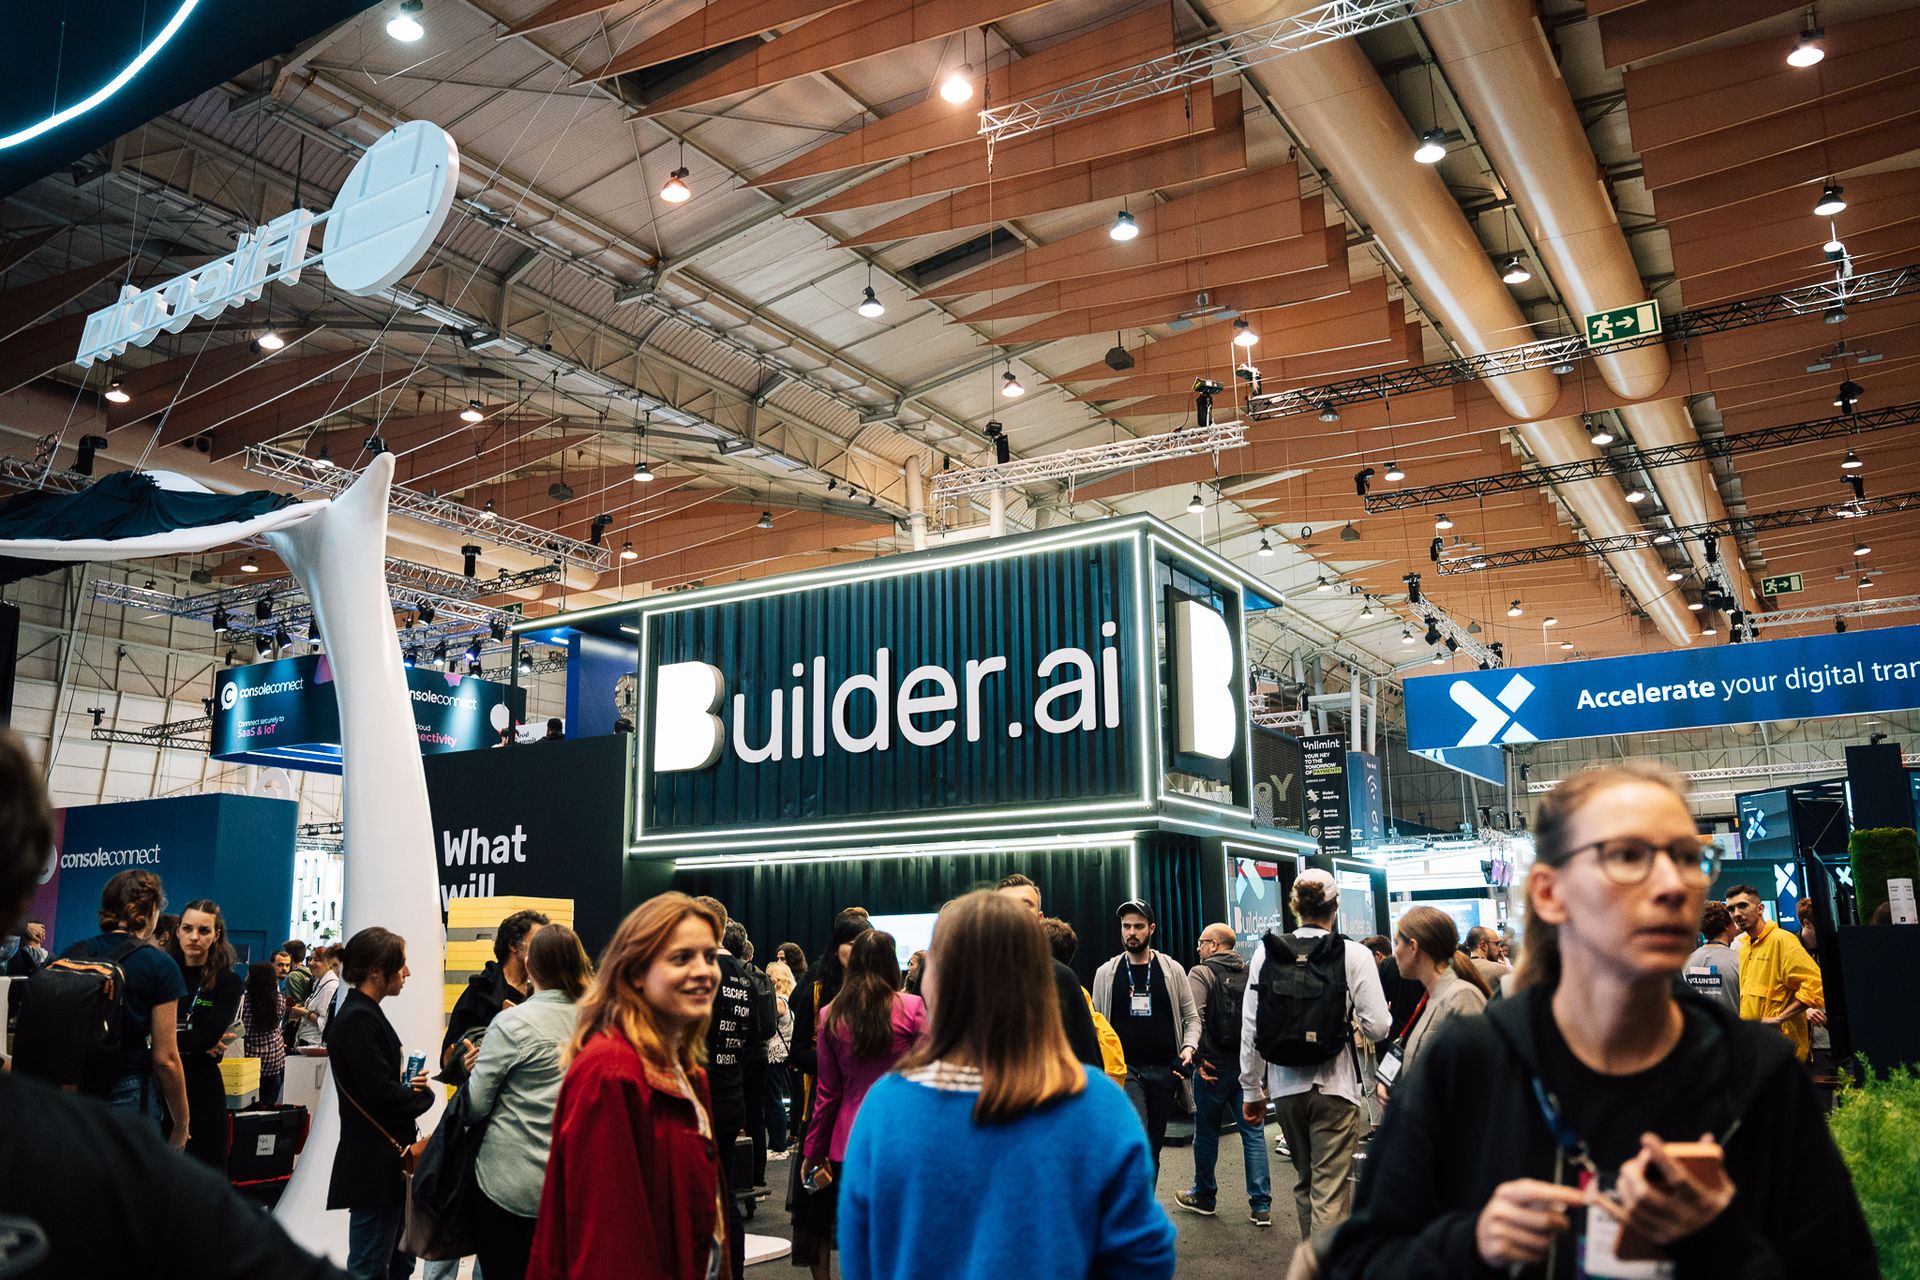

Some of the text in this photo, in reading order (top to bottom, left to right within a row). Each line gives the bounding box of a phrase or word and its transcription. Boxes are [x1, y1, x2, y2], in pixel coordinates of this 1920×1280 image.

[239, 677, 305, 699] consoleconnect
[1576, 679, 1716, 710] Accelerate
[1721, 673, 1778, 702] your
[1785, 660, 1865, 694] digital
[409, 688, 478, 711] nsoleconnect
[654, 622, 1120, 773] Builder.ai
[260, 716, 279, 726] securely
[279, 715, 286, 723] to
[236, 724, 277, 739] SaaS & IoT
[418, 733, 458, 748] ectivity
[1304, 762, 1336, 770] TOMORROW
[443, 824, 528, 867] What
[60, 843, 161, 869] consoleconnect
[1687, 976, 1721, 986] VOLUNTEER
[722, 985, 748, 1001] ESCAPE
[734, 1005, 750, 1017] FROM
[719, 1020, 737, 1031] BIG
